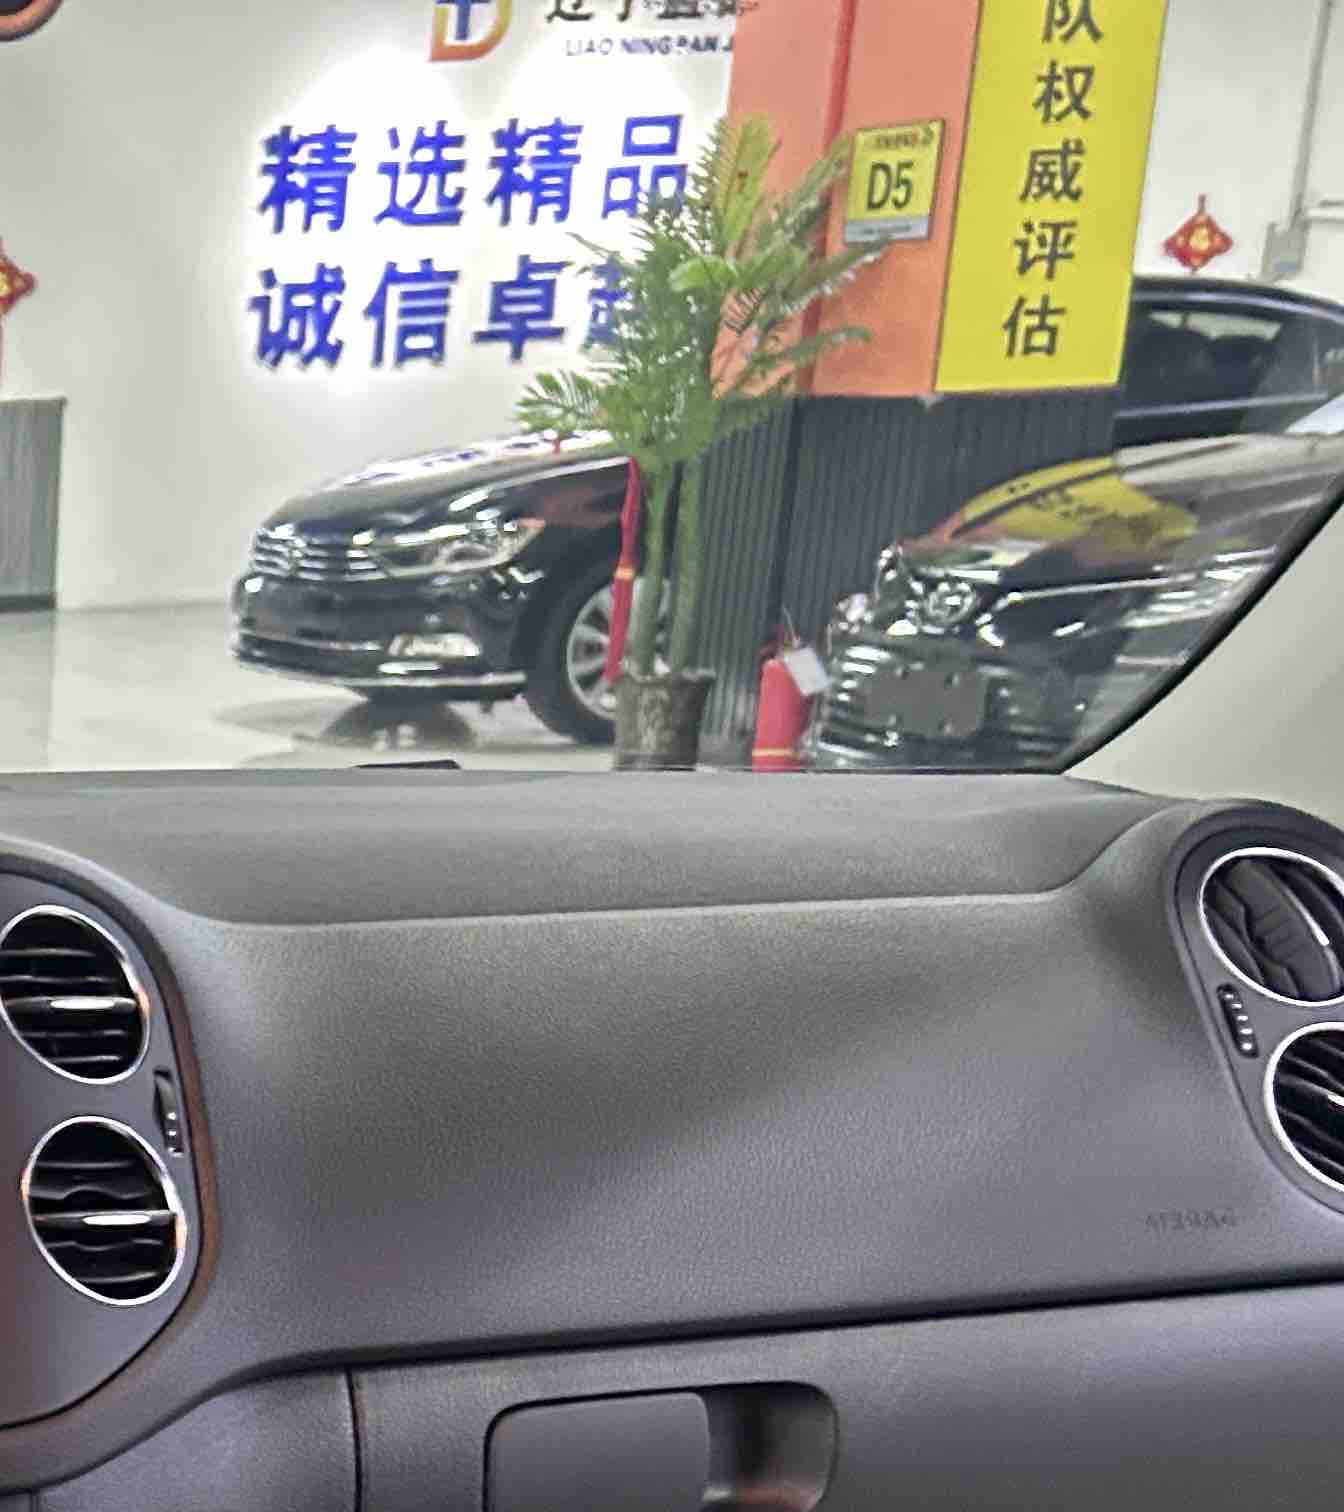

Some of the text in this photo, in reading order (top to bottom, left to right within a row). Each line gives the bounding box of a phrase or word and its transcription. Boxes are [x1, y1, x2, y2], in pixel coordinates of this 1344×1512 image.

[256, 113, 690, 234] 精选精品
[867, 161, 914, 211] D5
